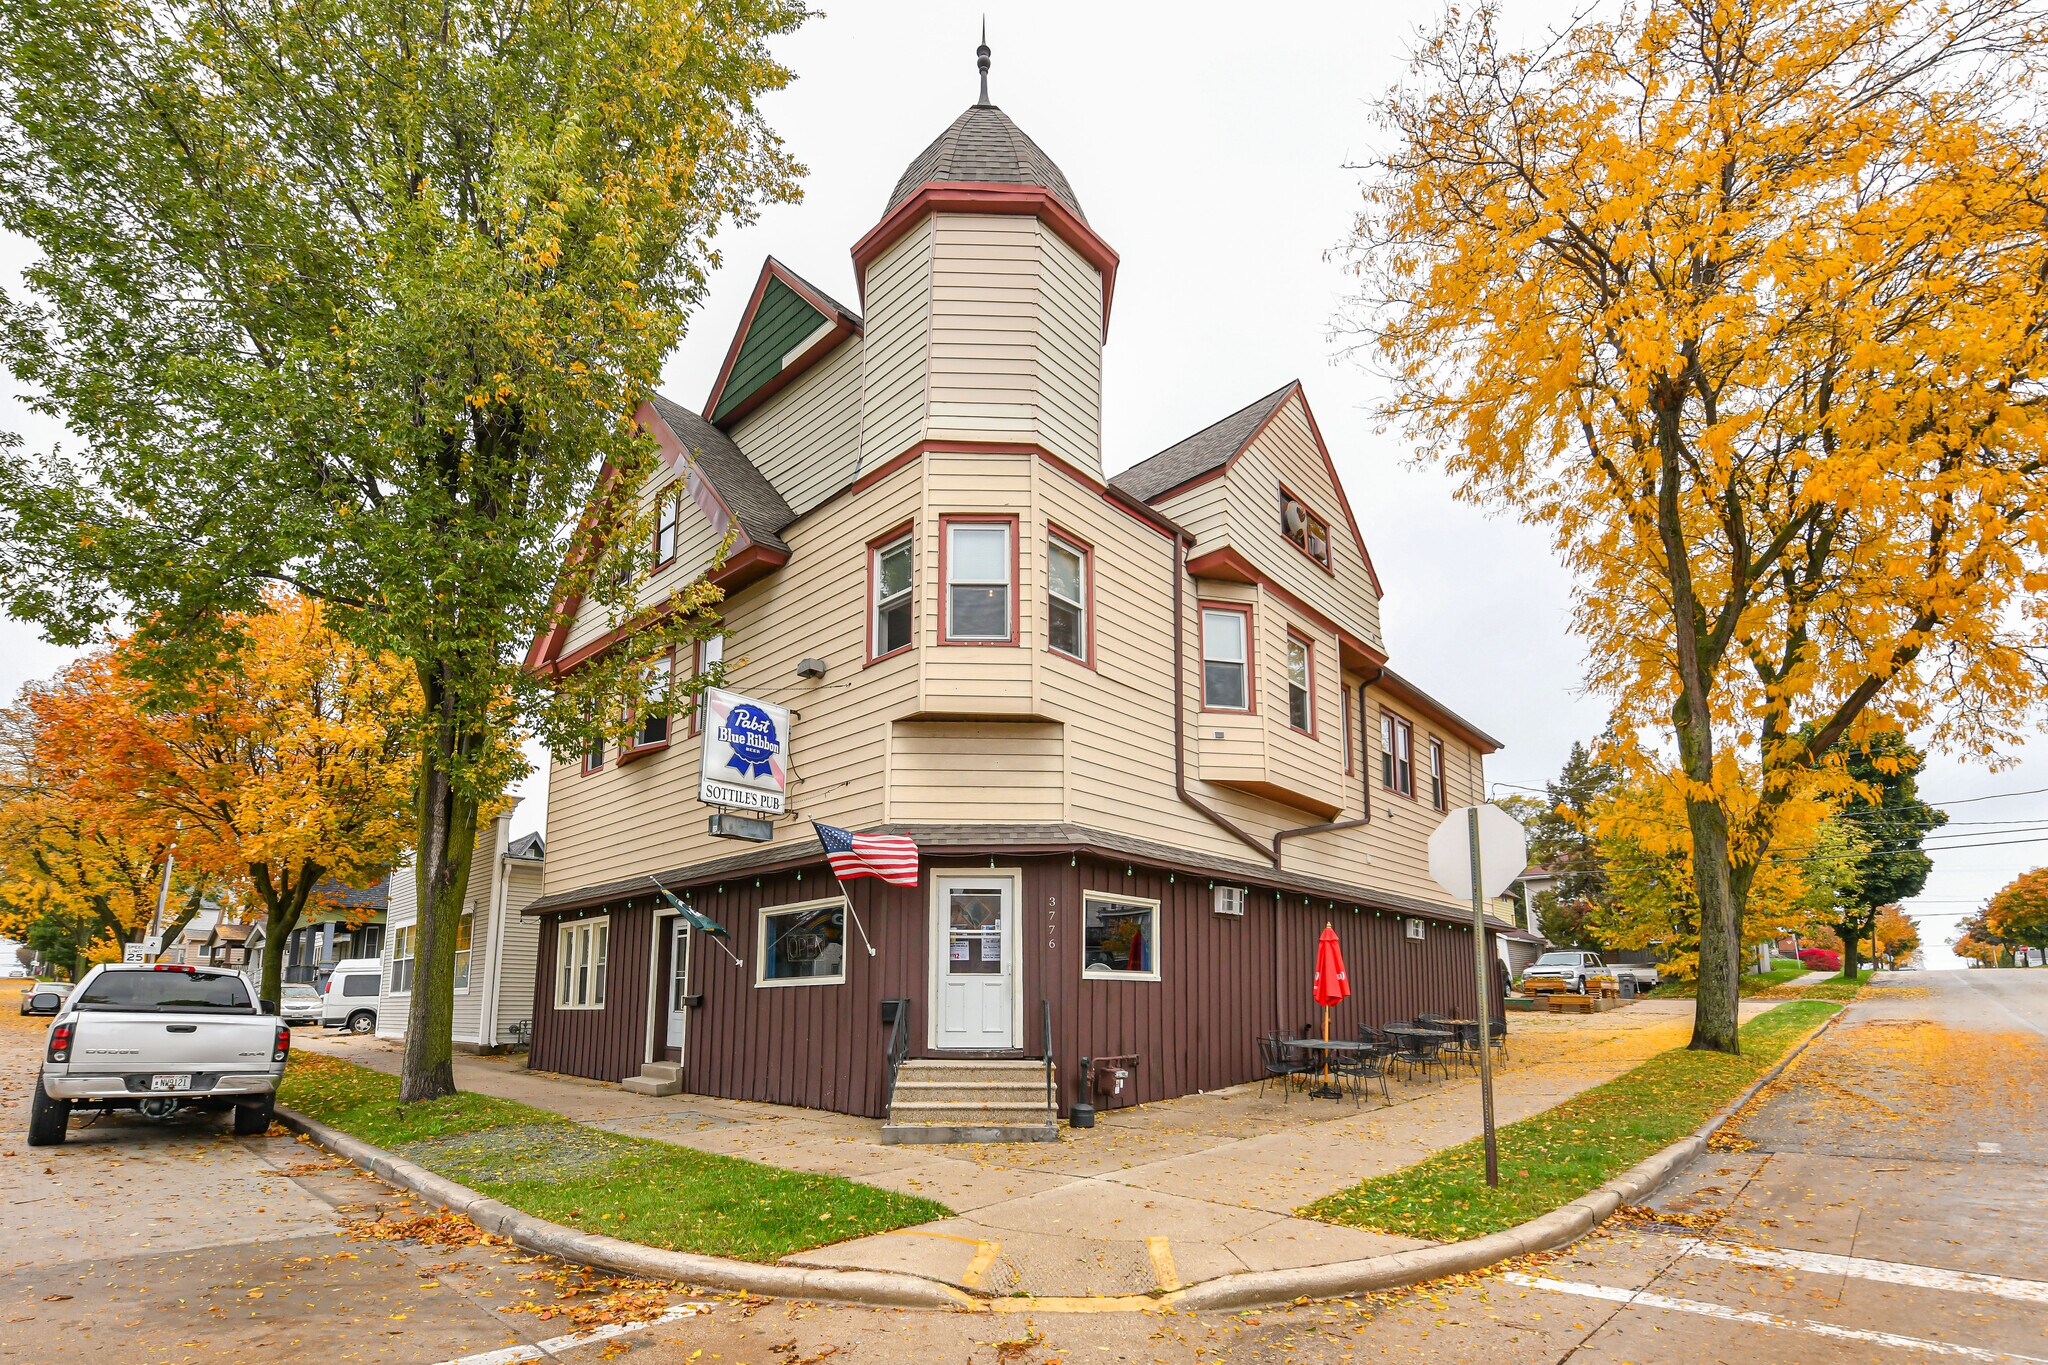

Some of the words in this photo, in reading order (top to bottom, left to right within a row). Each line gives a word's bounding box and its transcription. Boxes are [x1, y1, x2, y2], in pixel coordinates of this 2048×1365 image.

[734, 709, 770, 733] Pabst
[718, 726, 746, 745] Blue
[746, 731, 779, 754] Ribbon
[706, 784, 758, 806] SOTTILE'S
[760, 794, 780, 810] PUB
[1048, 896, 1056, 949] 3776
[126, 953, 143, 962] 25
